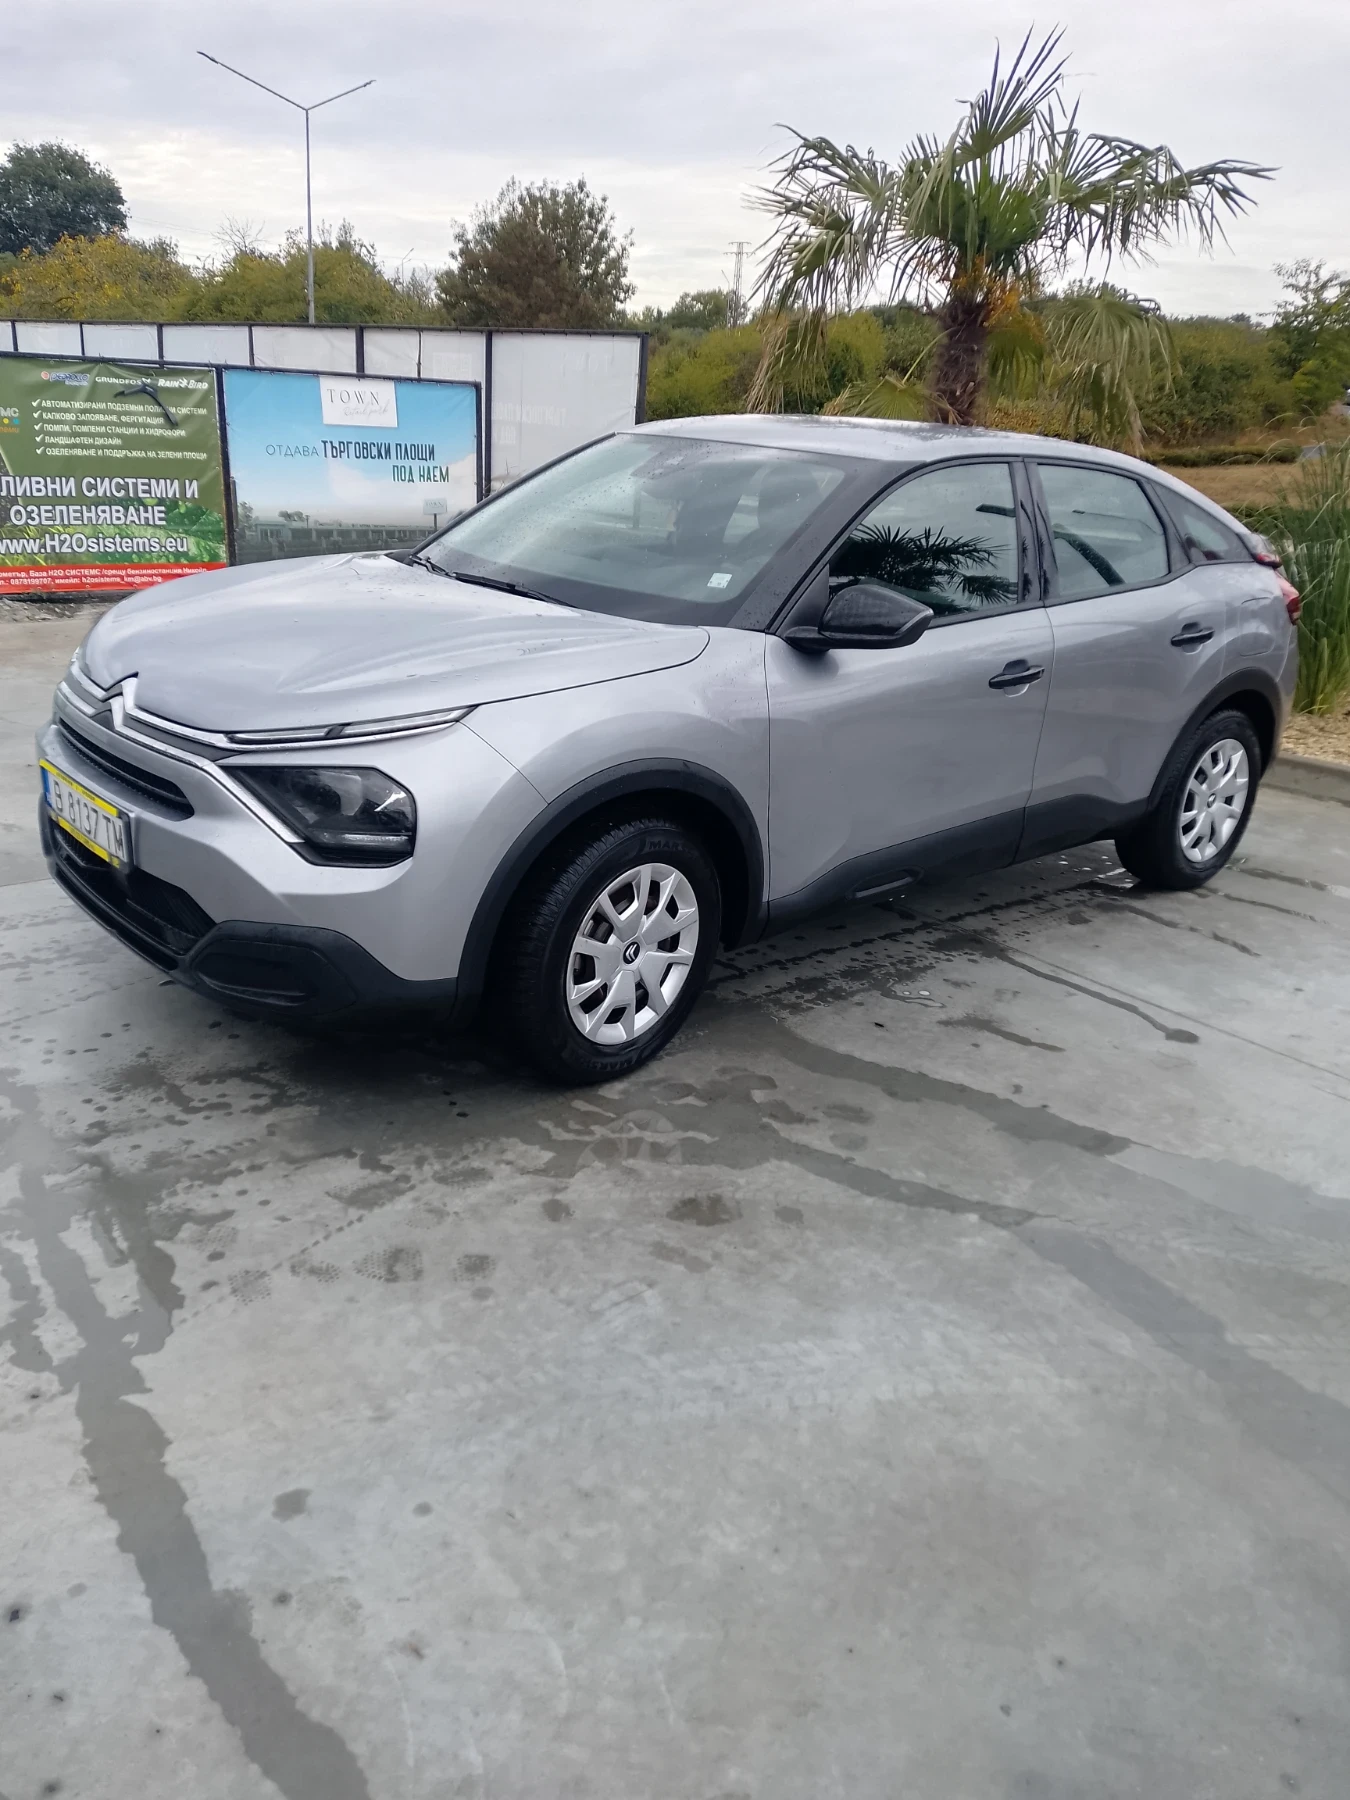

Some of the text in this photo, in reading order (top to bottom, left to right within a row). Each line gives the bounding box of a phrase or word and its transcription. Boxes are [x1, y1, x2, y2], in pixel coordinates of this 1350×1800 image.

[95, 376, 142, 385] GRUNDFOS
[157, 378, 208, 389] RAIN BIRD
[327, 388, 379, 405] TOWN
[41, 400, 106, 410] АВТОМАТИЗИРАНИ
[107, 402, 144, 412] ПОДЗЕМНИ
[176, 406, 207, 415] СИСТЕМИ
[42, 412, 76, 420] КАПКОВО
[43, 424, 71, 432] ПОМПИ,
[72, 425, 106, 433] ПОМПЕНИ
[106, 426, 139, 435] СТАНЦИИ
[145, 428, 186, 437] ХИДРОФОРИ
[44, 436, 122, 445] ЛАНДШАФТЕН ДИЗАЙН
[46, 447, 97, 456] ОЗЕЛЕНЯВАНЕ
[103, 449, 146, 457] ПОДДРЪЖКА
[147, 450, 157, 458] НА
[183, 451, 207, 460] ПЛОЩИ
[265, 440, 435, 462] ОТДАВА ТЪРГОВСКИ ПЛОЩИ
[392, 464, 449, 483] ПОД НАЕМ
[0, 476, 199, 498] ЛИВНИ СИСТЕМИ И
[9, 505, 166, 525] ОЗЕЛЕНЯВАНЕ
[65, 568, 101, 576] СИСТЕМС
[53, 779, 63, 813] B
[68, 791, 98, 840] 8137
[101, 813, 125, 859] TM
